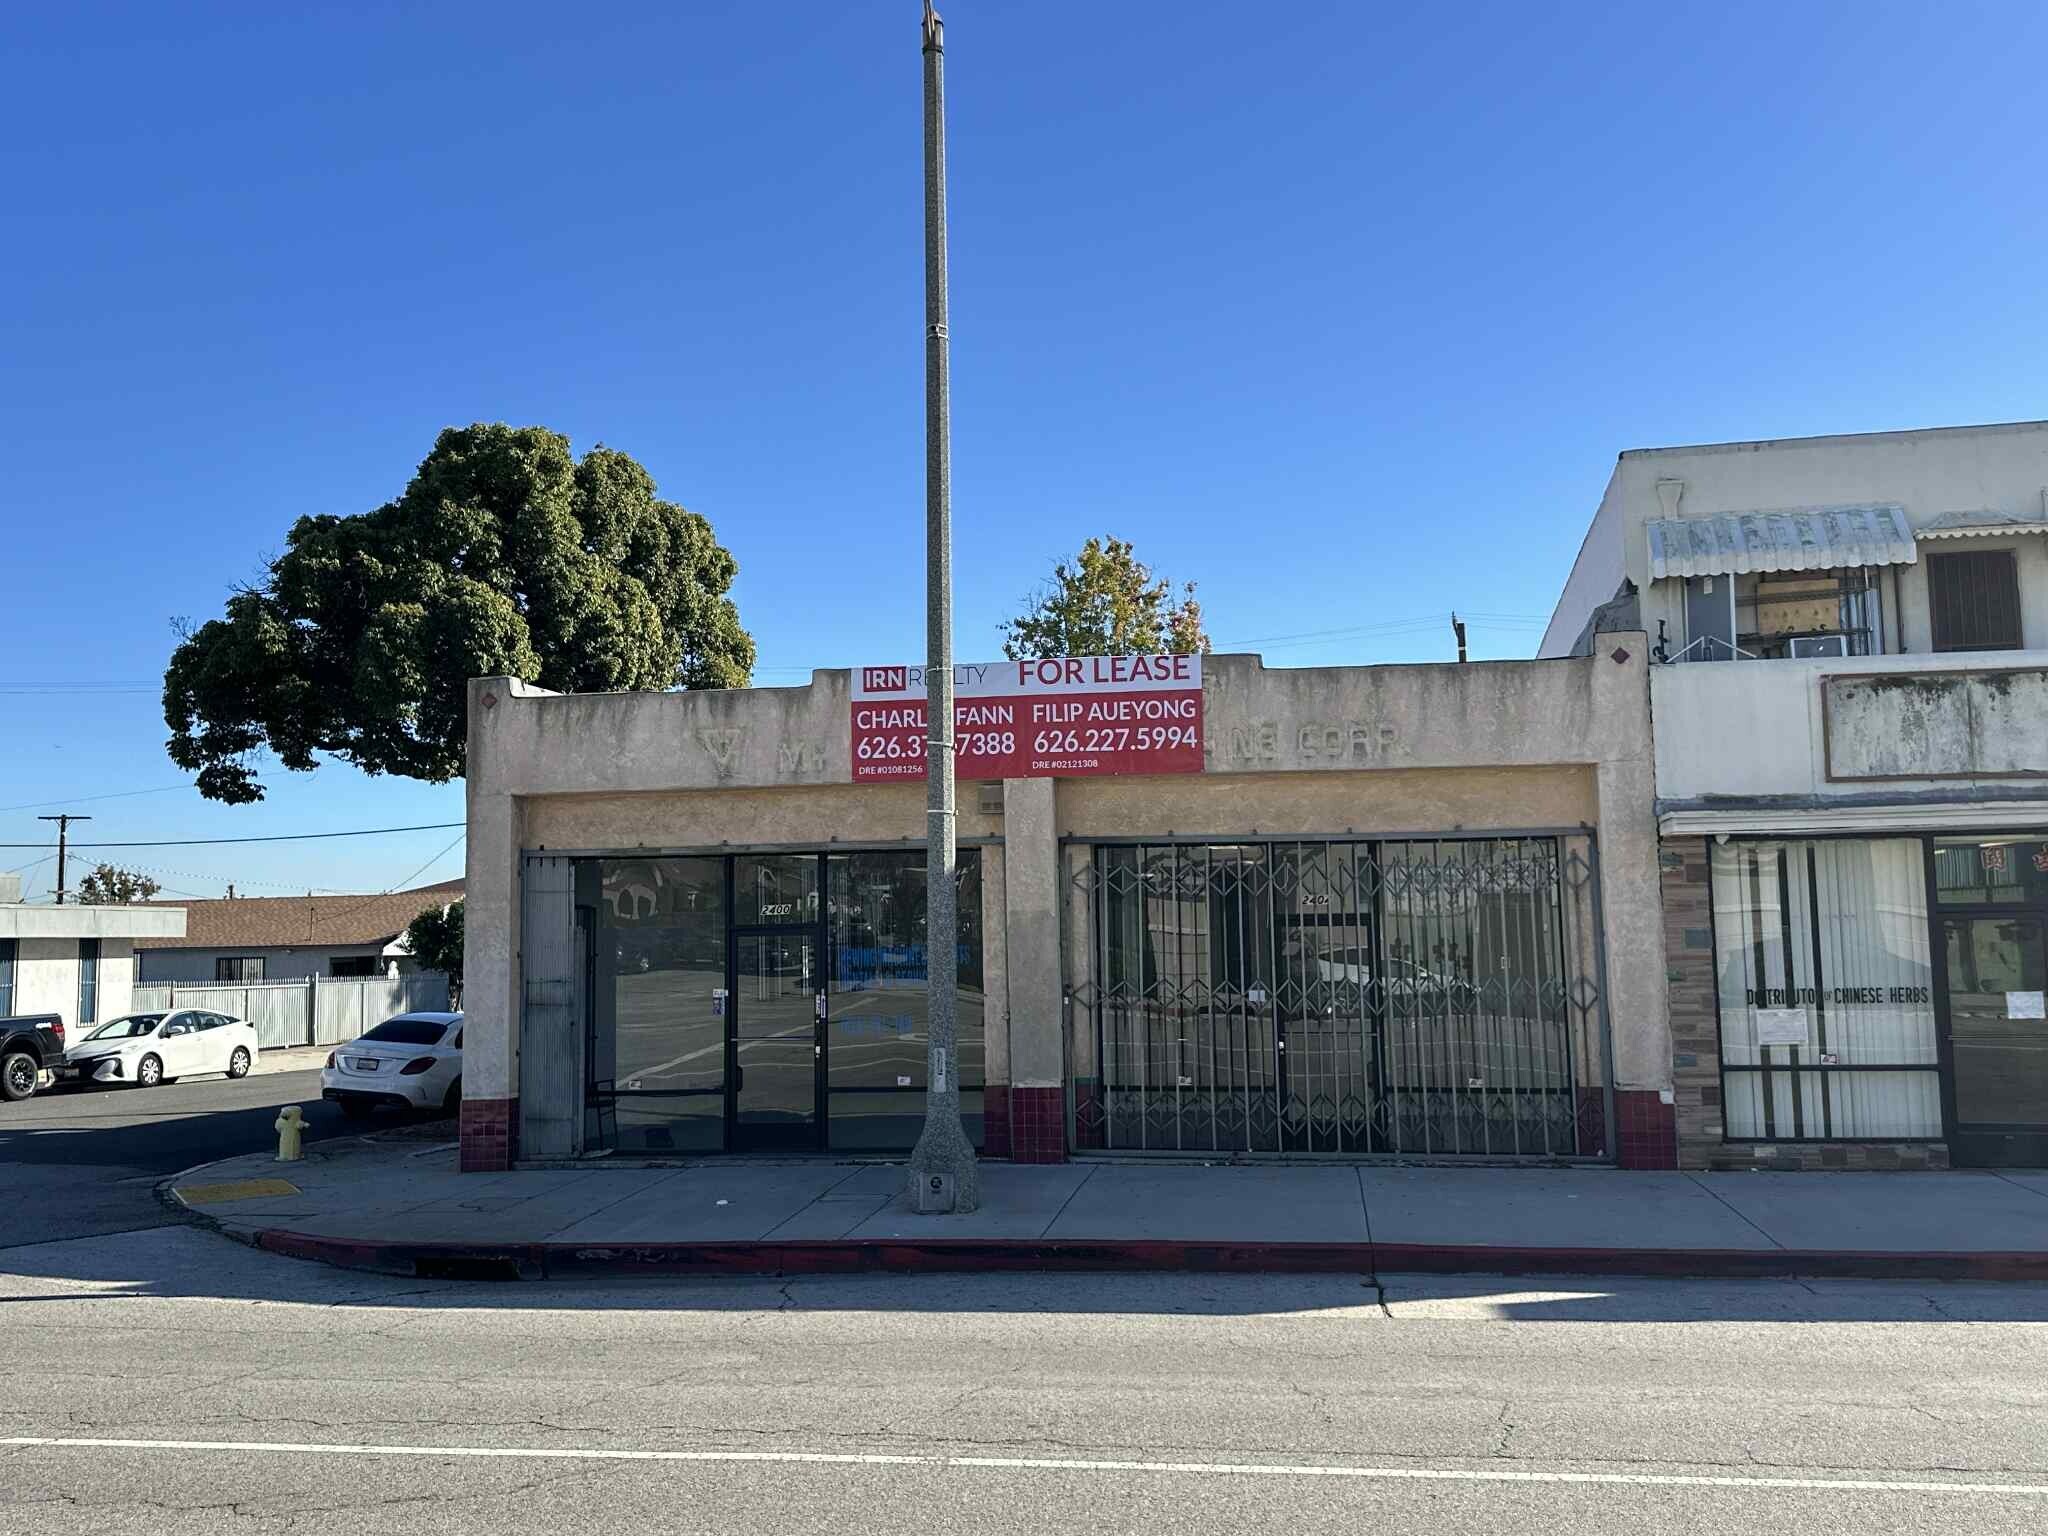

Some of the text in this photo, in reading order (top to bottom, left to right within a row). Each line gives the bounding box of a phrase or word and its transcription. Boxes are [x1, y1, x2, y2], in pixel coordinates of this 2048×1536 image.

[866, 666, 987, 689] IRN RLTY
[1019, 655, 1190, 686] FOR LEASE
[857, 705, 1014, 729] CHARL FANN
[1033, 699, 1197, 723] FILIP AUEYONG
[1034, 726, 1198, 753] 626.227.5994
[858, 766, 876, 775] DRE
[1032, 760, 1050, 769] DRE
[761, 903, 791, 915] 2400
[1834, 987, 1884, 1004] CHINESE
[1890, 986, 1929, 1004] HERBS
